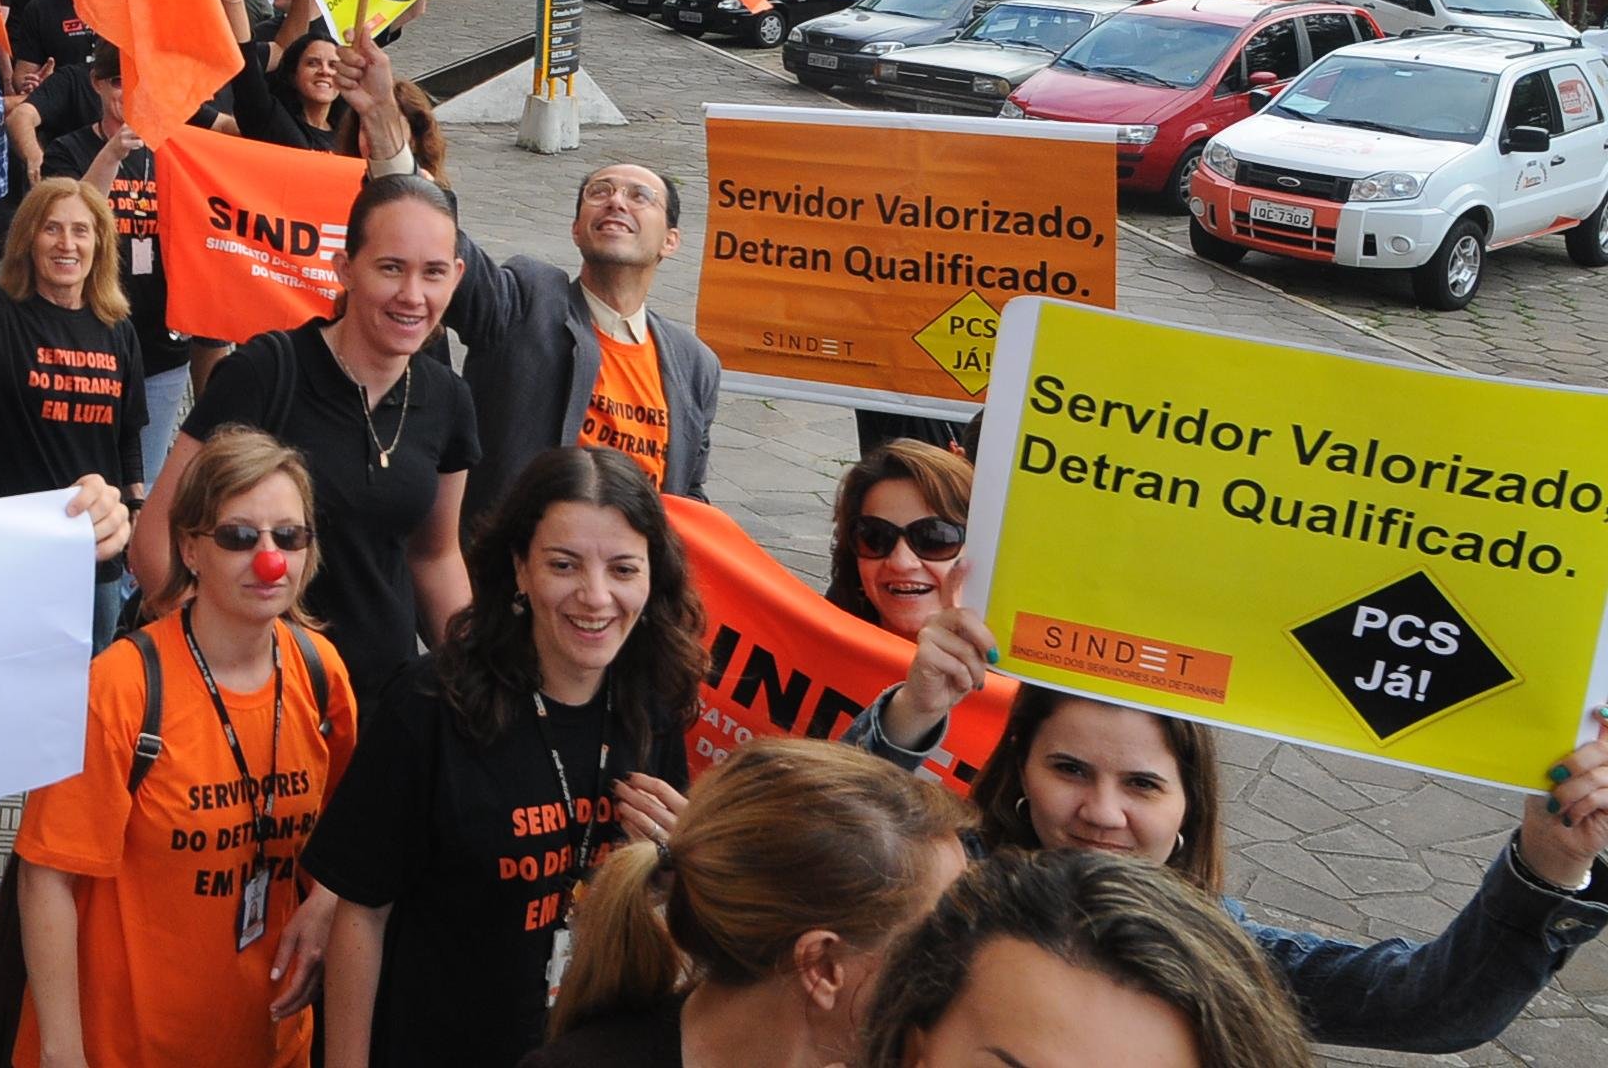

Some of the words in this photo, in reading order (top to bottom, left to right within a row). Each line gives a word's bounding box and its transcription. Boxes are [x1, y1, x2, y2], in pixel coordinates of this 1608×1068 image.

[207, 196, 348, 261] SINDE
[717, 178, 865, 221] Servidor
[875, 192, 1105, 248] Valorizado,
[714, 230, 832, 273] Detran
[844, 245, 1090, 298] Qualificado.
[762, 331, 855, 357] SINDET
[950, 315, 998, 339] PCS
[28, 370, 50, 390] DO
[953, 346, 991, 373] JÁ!
[42, 400, 68, 421] EM
[74, 403, 113, 424] LUTA
[1029, 373, 1273, 458] Servidor
[1019, 433, 1201, 509] Detran
[1222, 477, 1576, 578] Qualificado.
[1044, 626, 1194, 676] SINDET
[1351, 605, 1461, 657] PCS
[1012, 645, 1062, 664] SINDICATO
[1064, 656, 1085, 670] DOS
[1087, 661, 1150, 682] SERVIDORES
[1150, 674, 1167, 687] DO
[1354, 659, 1434, 704] Já!
[171, 828, 207, 852] DO
[194, 869, 234, 897] EM
[499, 855, 539, 882] DO
[524, 892, 561, 932] EM
